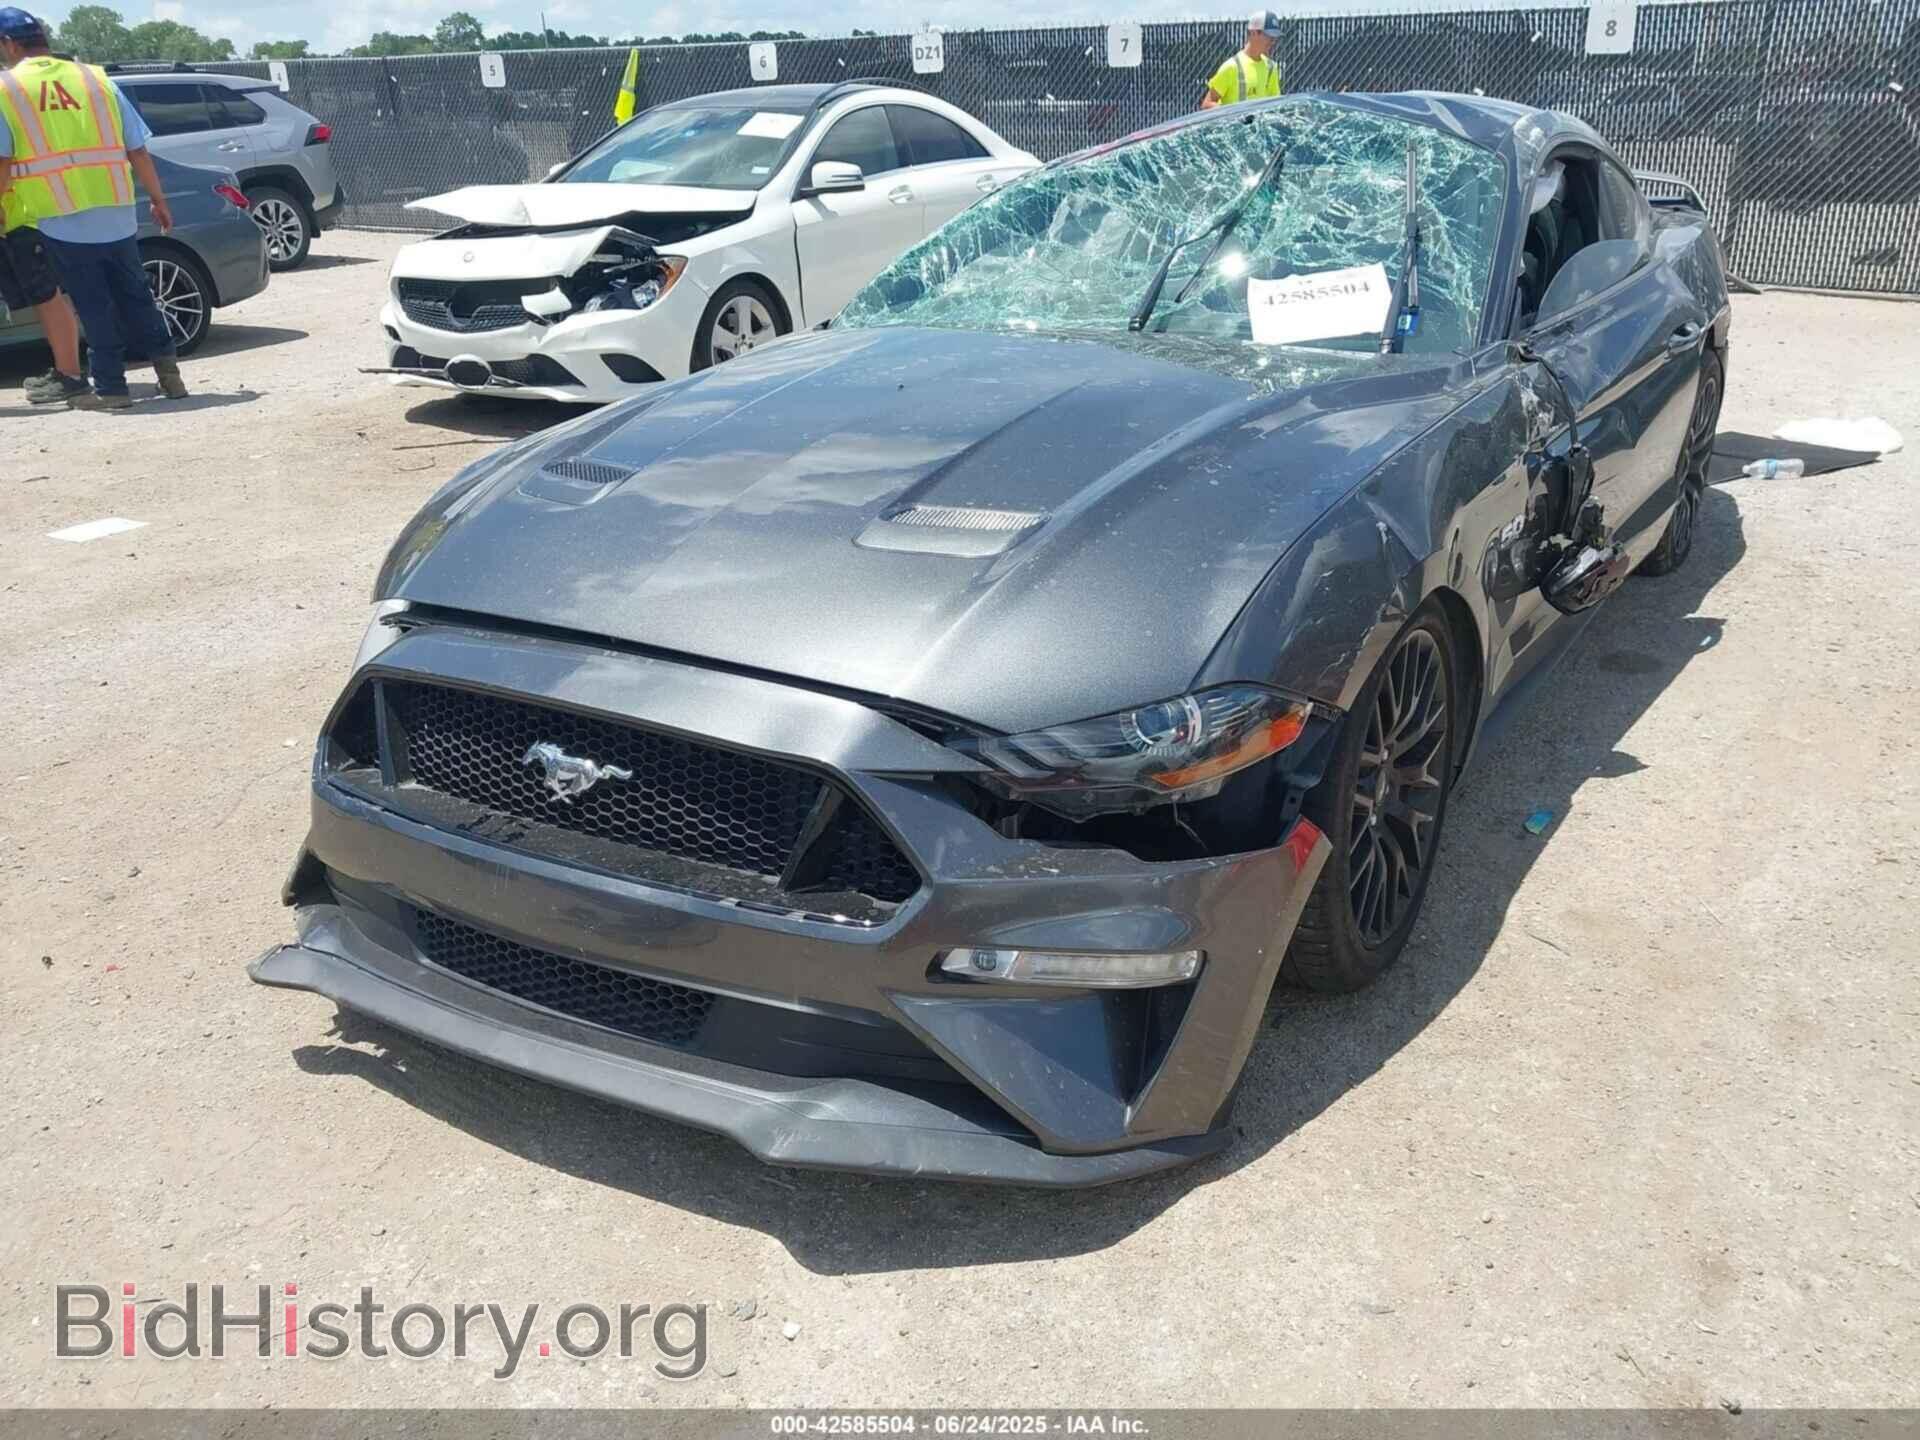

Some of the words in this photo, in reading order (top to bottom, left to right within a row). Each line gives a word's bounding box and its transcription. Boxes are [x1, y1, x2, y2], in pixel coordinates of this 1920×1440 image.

[1605, 19, 1617, 37] 8
[1120, 38, 1129, 53] 7
[914, 46, 941, 60] DZ1
[759, 55, 768, 68] 6
[488, 64, 496, 76] 5
[1263, 281, 1371, 306] 42585504
